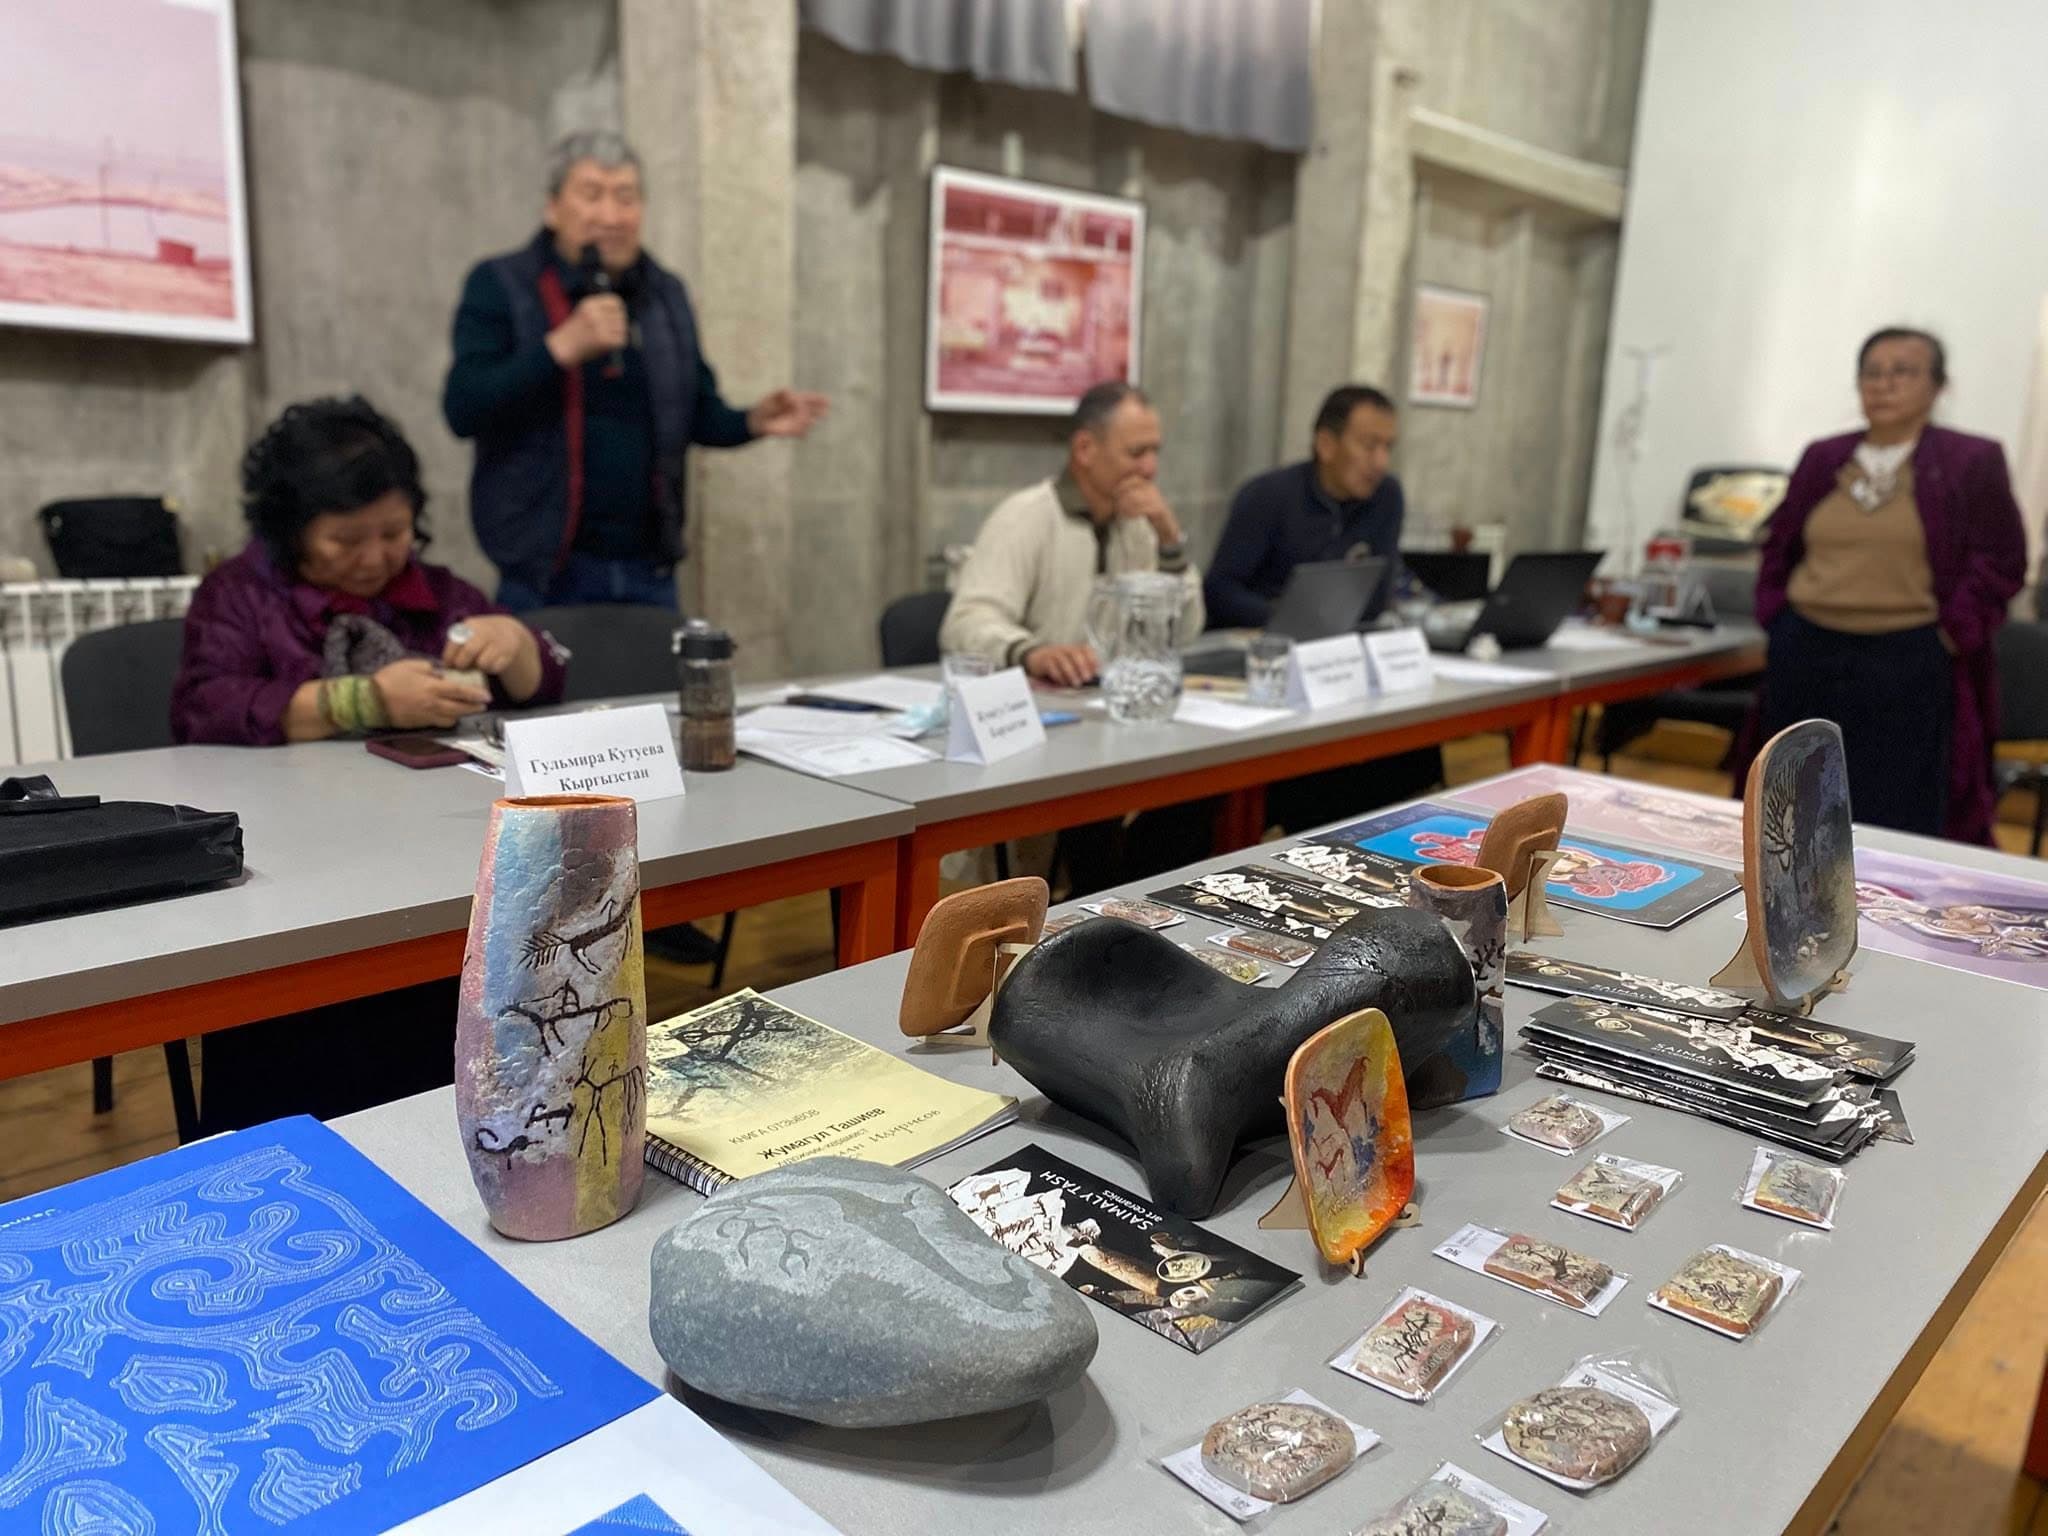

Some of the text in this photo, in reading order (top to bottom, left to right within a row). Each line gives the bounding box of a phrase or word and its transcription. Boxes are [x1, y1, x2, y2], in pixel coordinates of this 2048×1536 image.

[529, 744, 665, 775] Гульмира Кутуева
[560, 768, 649, 791] Кыргызстан
[1231, 912, 1279, 928] SAIMALY
[1279, 925, 1310, 939] TASH
[1589, 984, 1655, 1000] SAIMALY
[1655, 1043, 1776, 1080] SAIMALY TASH
[729, 1109, 820, 1145] КНИГА ОТЗЫВОВ
[757, 1130, 830, 1160] Жумагул
[829, 1106, 886, 1134] Ташиев
[1039, 1170, 1154, 1231] SAIMALY TASH
[1102, 1189, 1164, 1222] art ceramics
